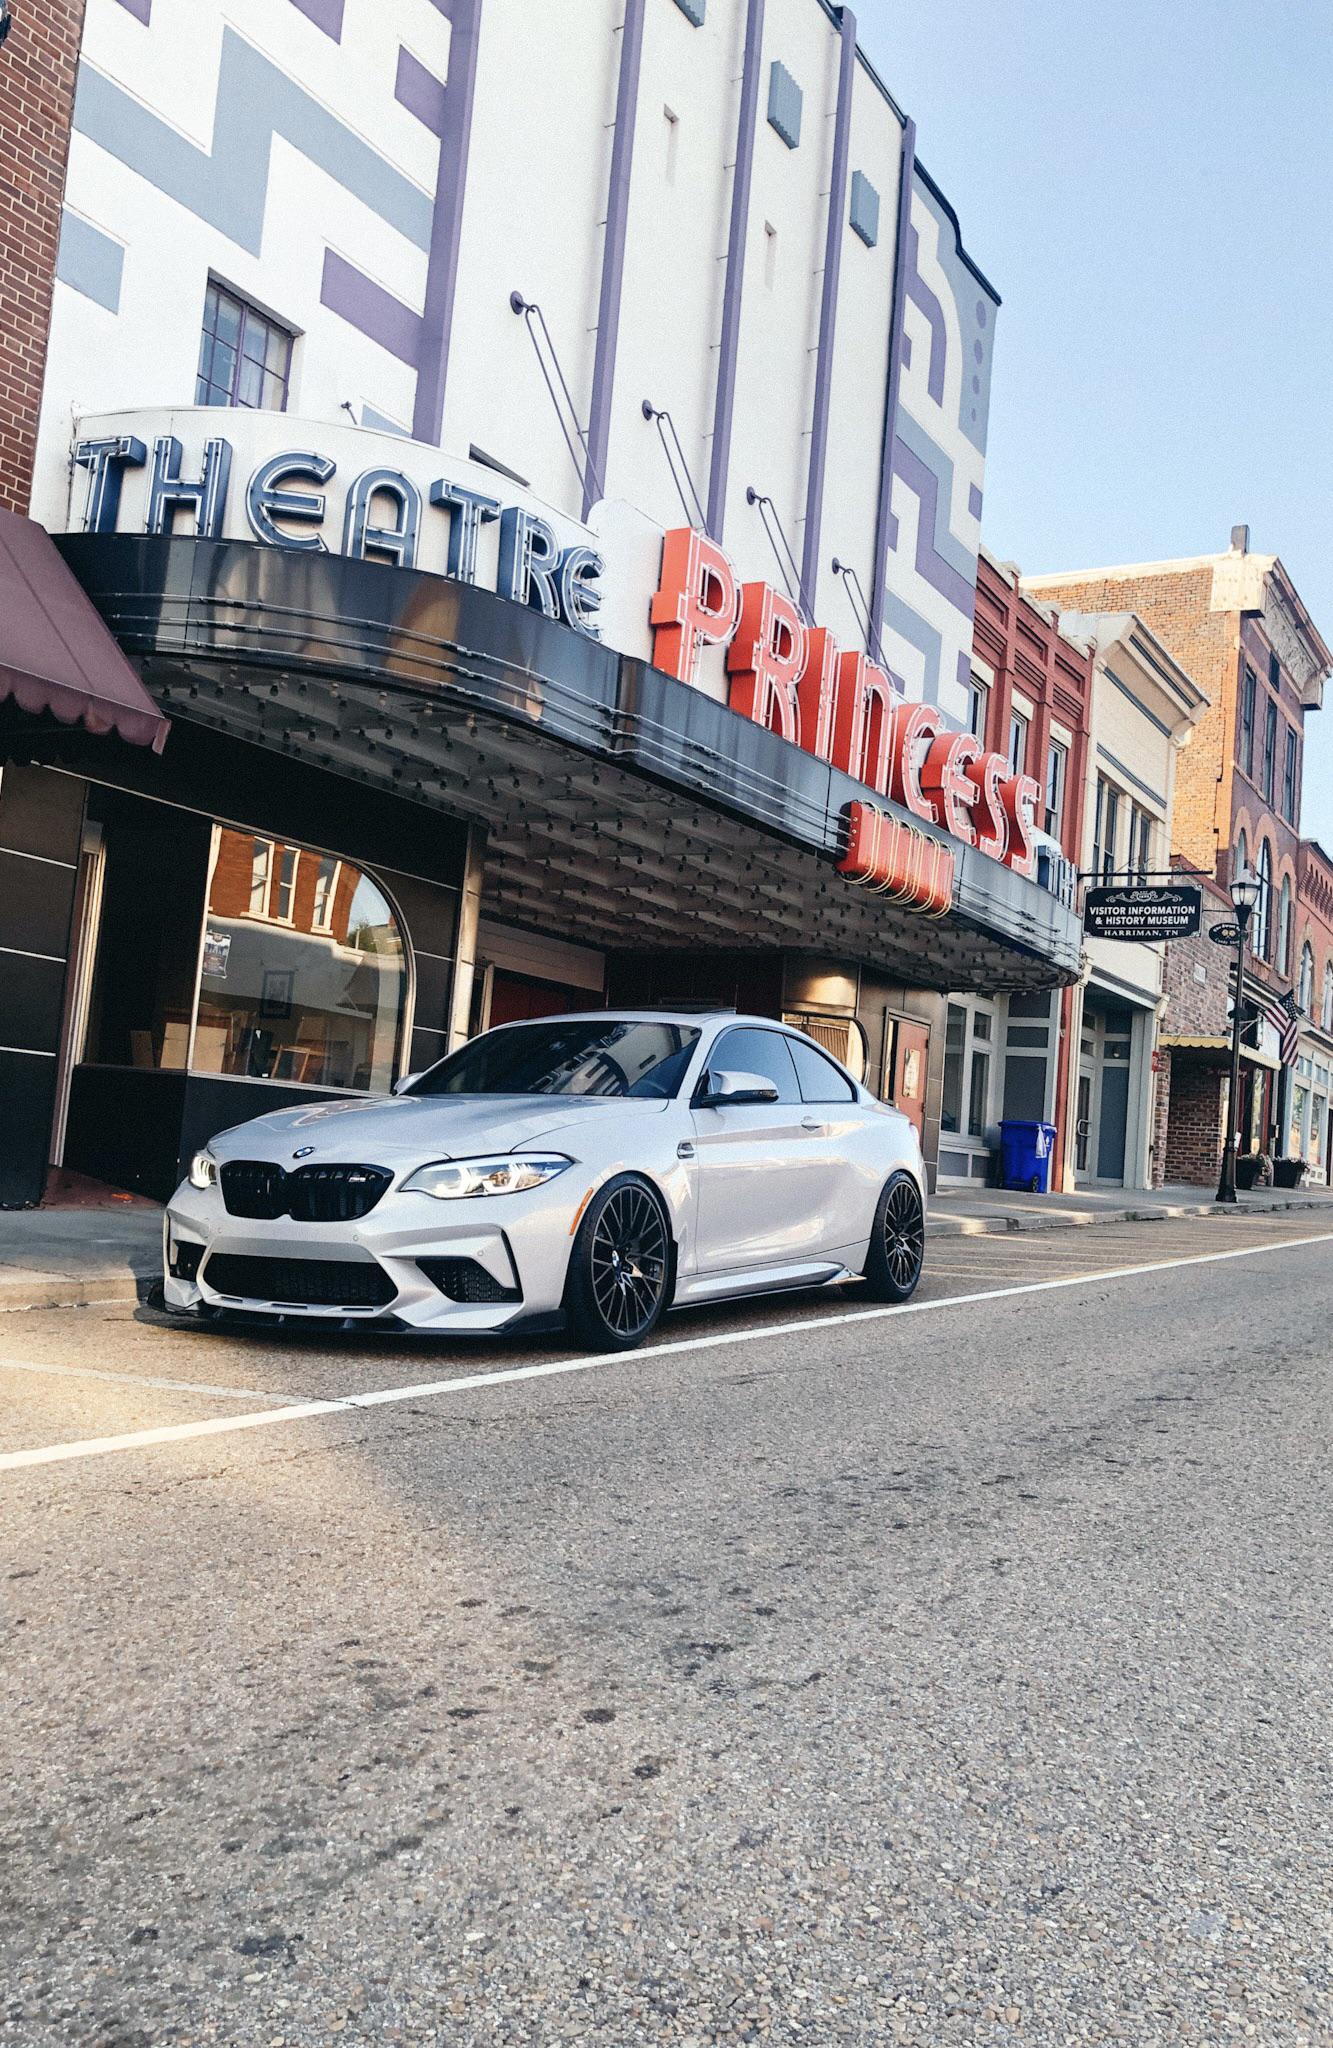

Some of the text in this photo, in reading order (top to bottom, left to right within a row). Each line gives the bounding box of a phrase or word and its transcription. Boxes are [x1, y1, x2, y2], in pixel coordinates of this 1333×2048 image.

[76, 436, 606, 642] THEATRE
[651, 528, 1041, 875] PRINCESS
[1089, 905, 1196, 915] VISITOR INFORMATION
[1095, 915, 1189, 925] & HISTORY MUSEUM
